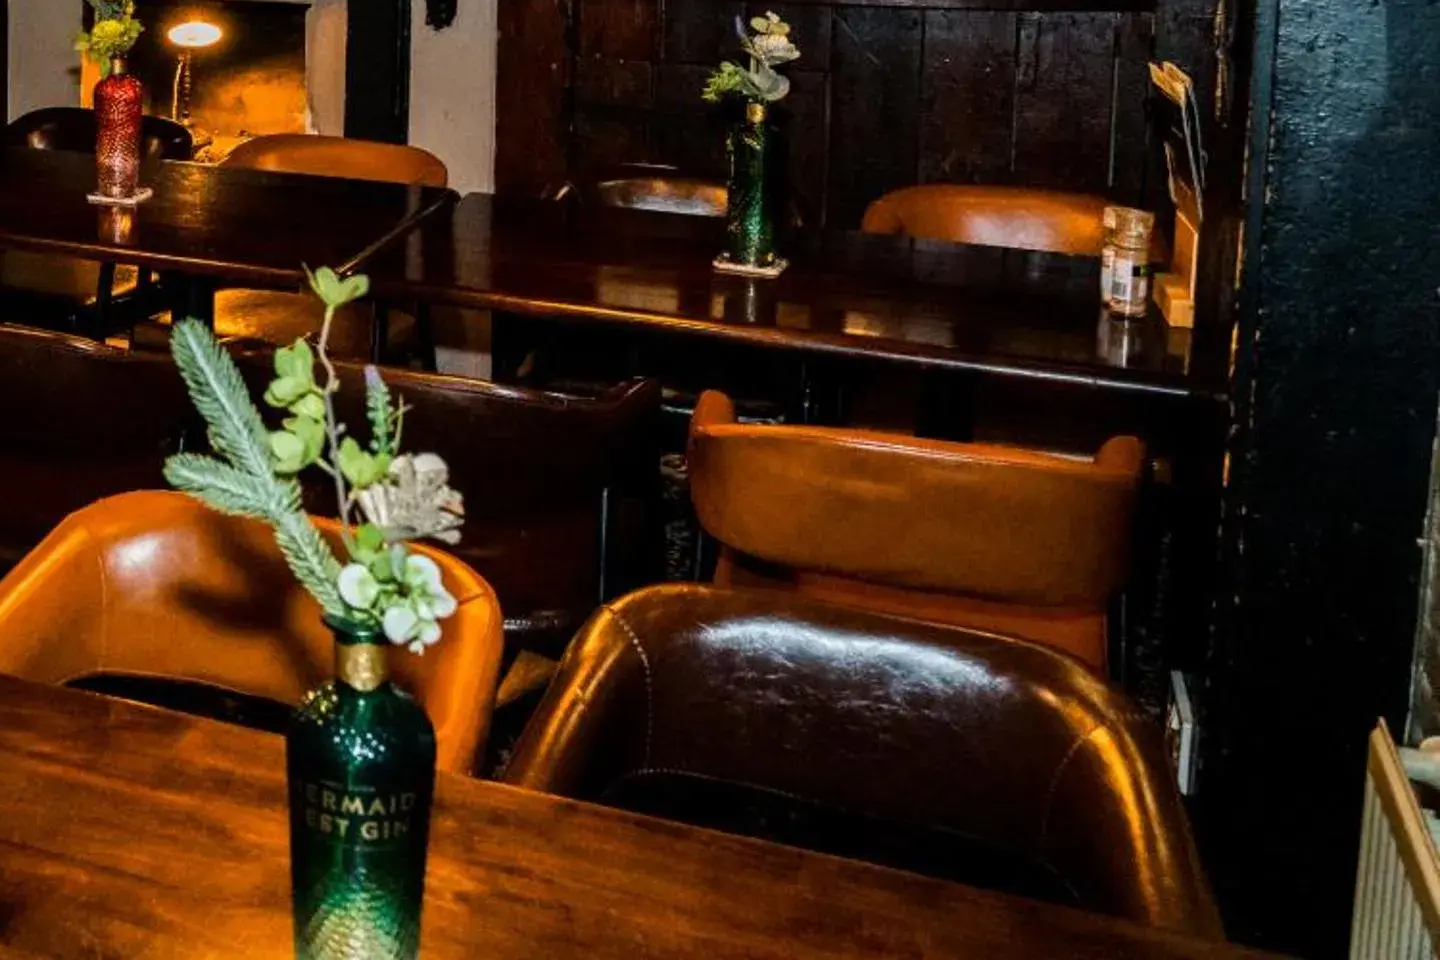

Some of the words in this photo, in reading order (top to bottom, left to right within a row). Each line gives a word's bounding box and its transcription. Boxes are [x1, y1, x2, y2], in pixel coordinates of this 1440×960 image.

[300, 782, 417, 816] ERMAID
[305, 808, 351, 838] EST
[359, 813, 412, 842] GIN
